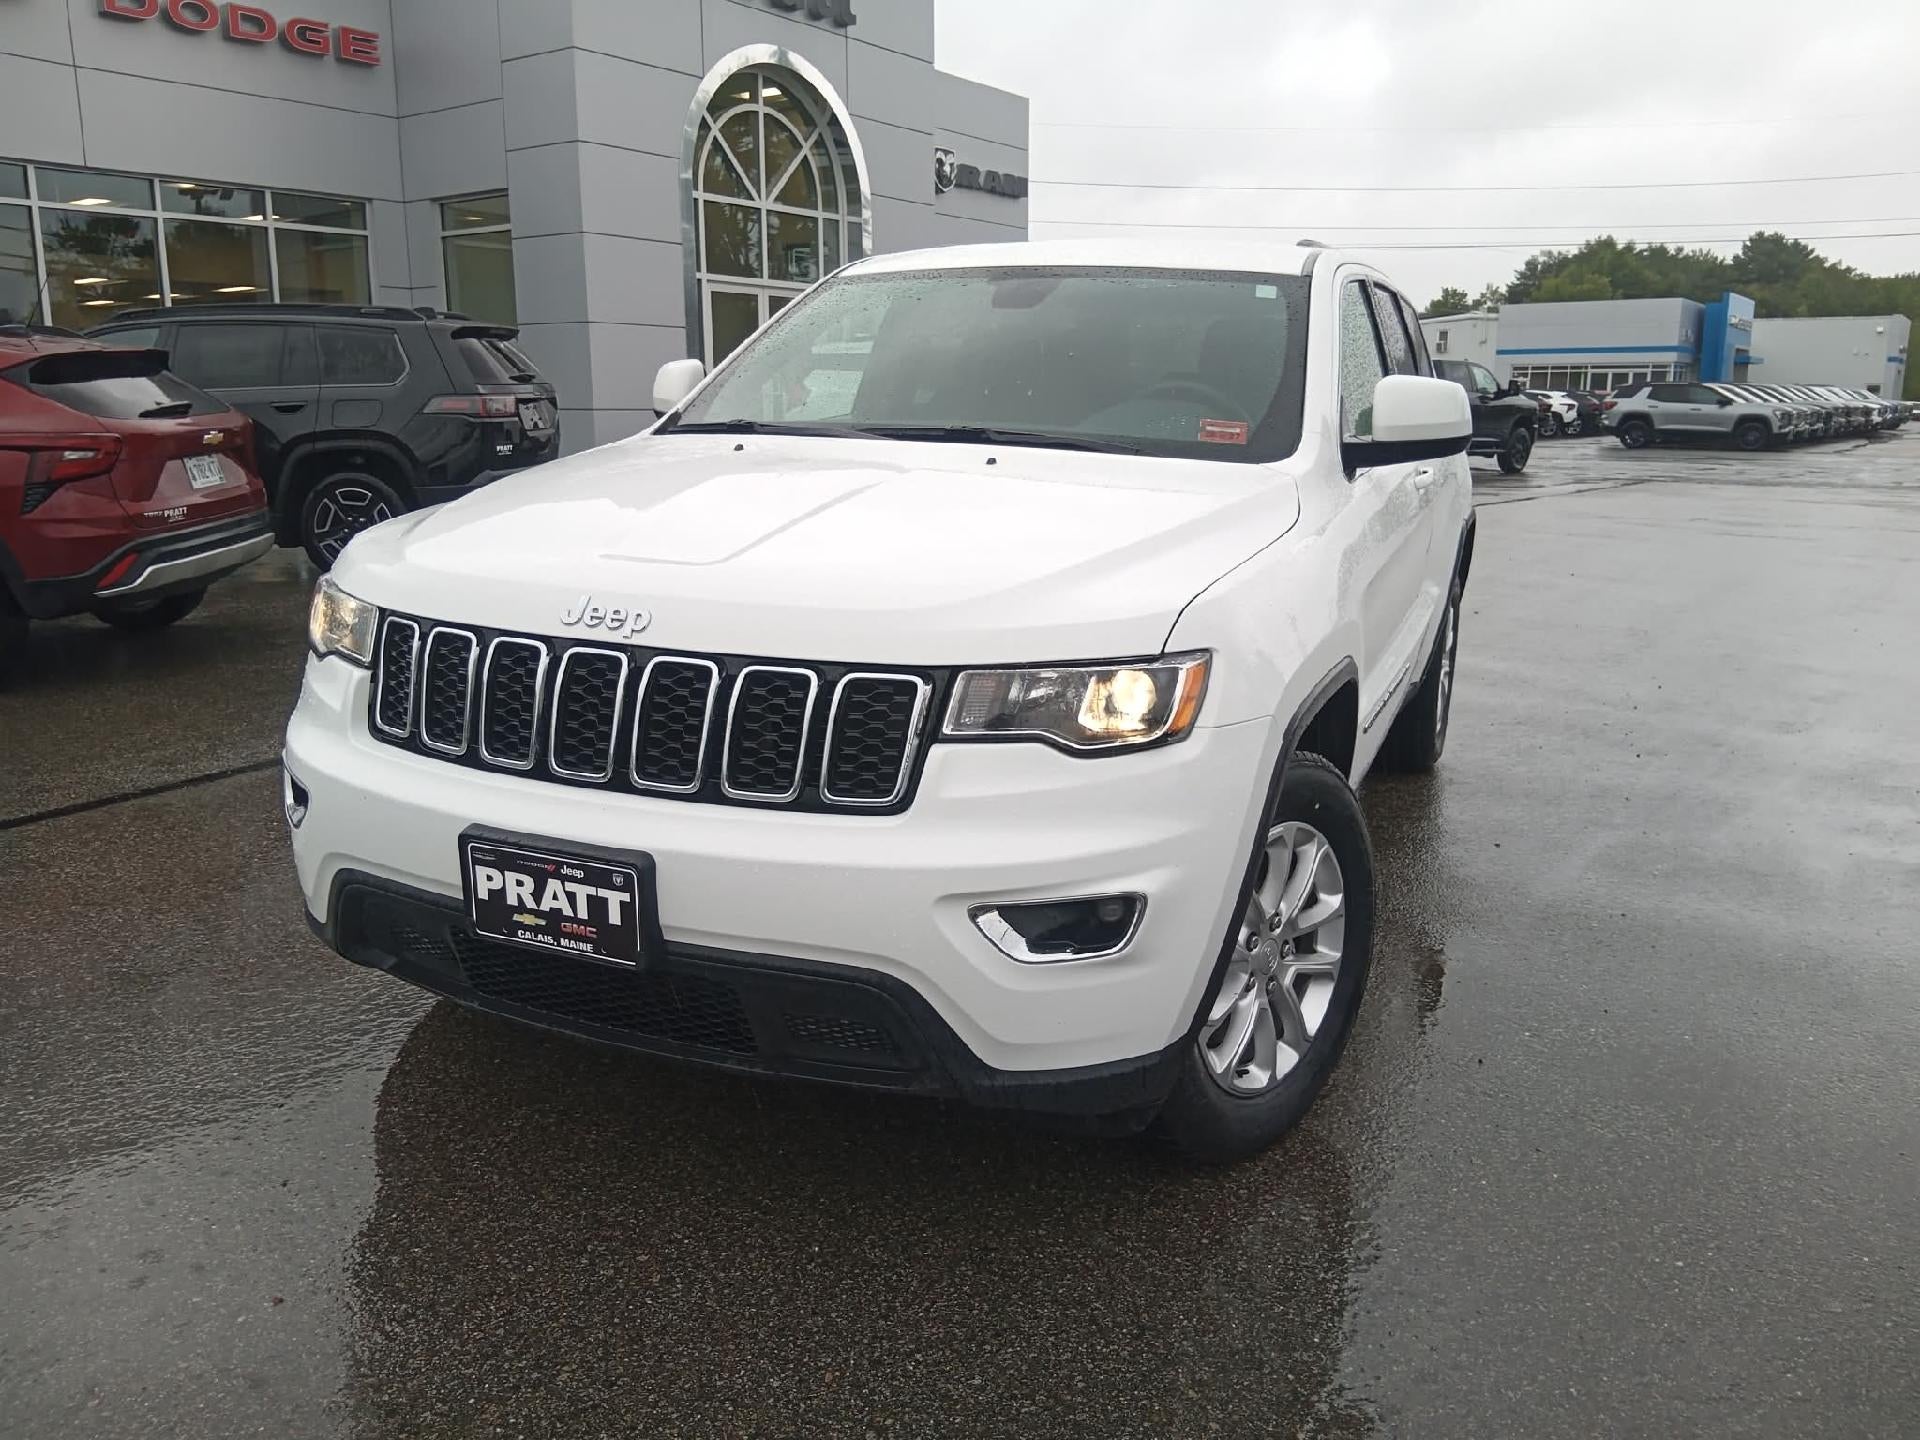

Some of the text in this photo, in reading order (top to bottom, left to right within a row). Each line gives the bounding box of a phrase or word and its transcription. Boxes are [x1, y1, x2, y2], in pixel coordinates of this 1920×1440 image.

[956, 163, 1028, 198] RAM
[560, 593, 652, 639] Jeep
[560, 864, 585, 879] Jeep
[475, 865, 631, 926] PRATT
[517, 929, 594, 953] CALAIS, MAINE
[560, 922, 597, 939] GMC
